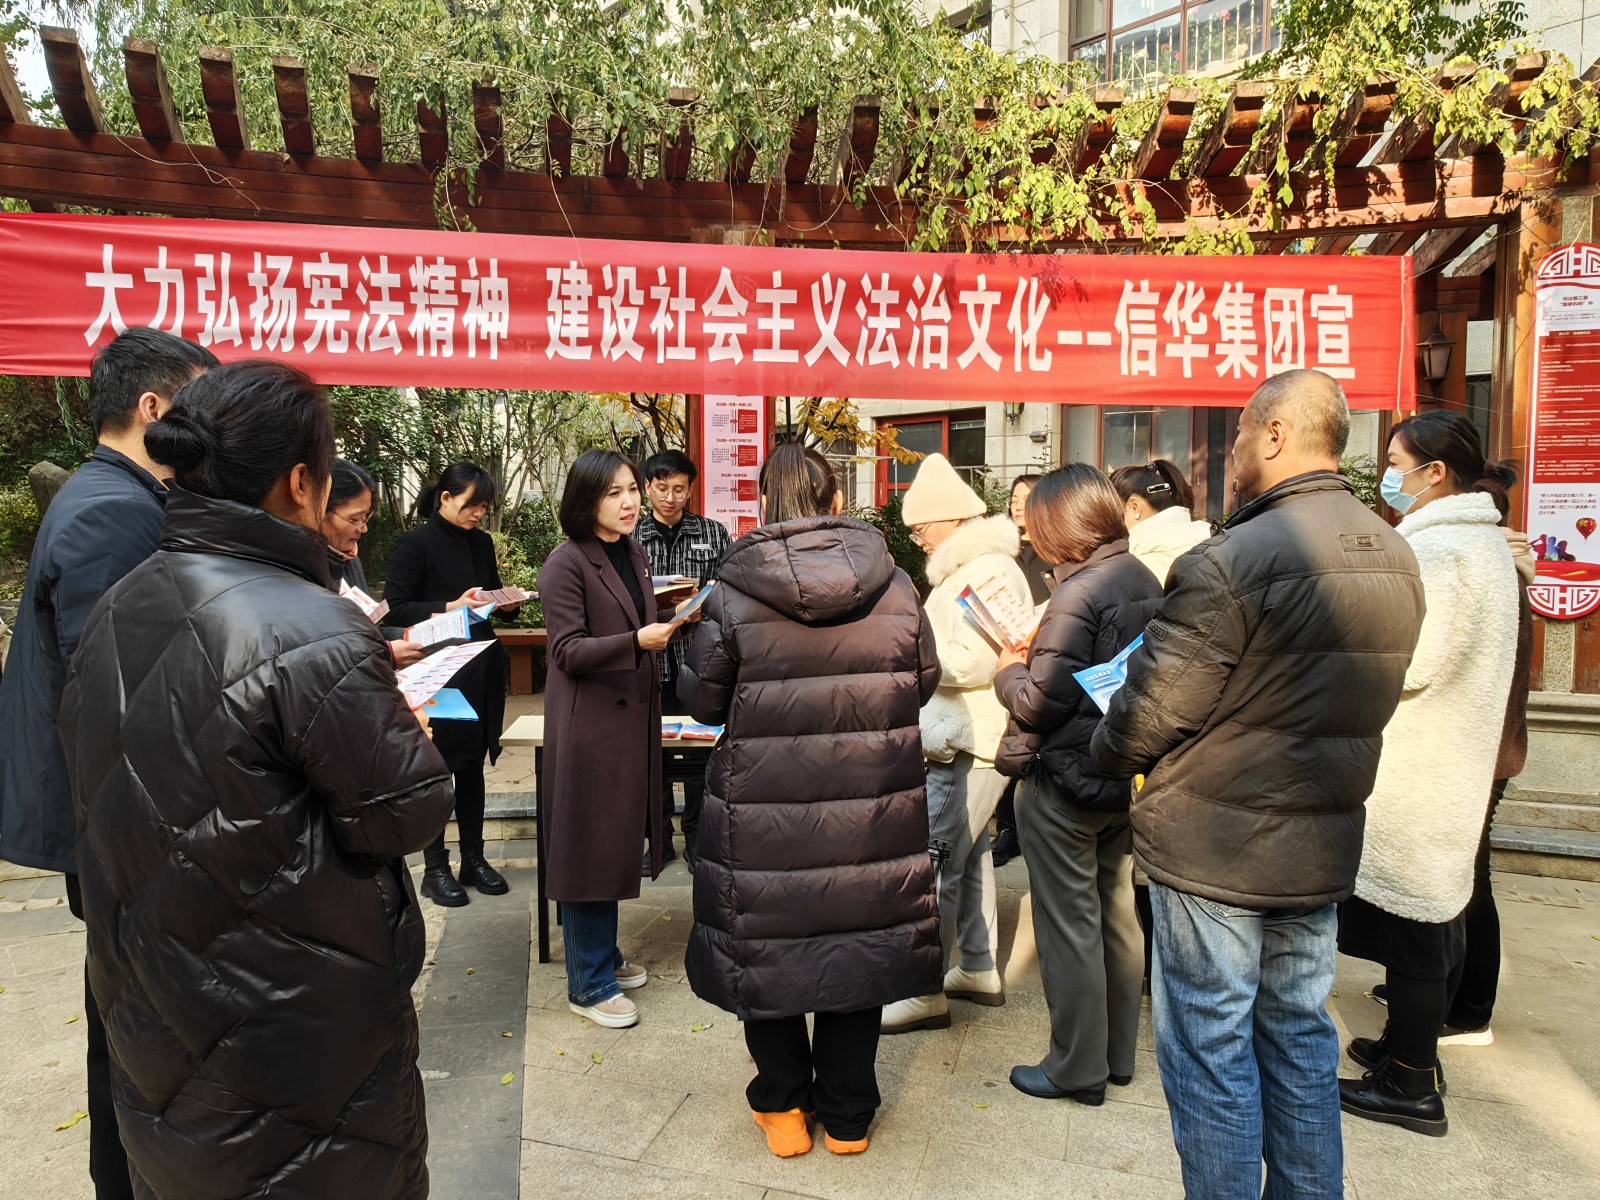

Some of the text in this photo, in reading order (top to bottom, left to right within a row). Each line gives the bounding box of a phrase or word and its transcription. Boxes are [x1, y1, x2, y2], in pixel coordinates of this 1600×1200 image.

[84, 243, 509, 360] 大力弘扬宪法精神
